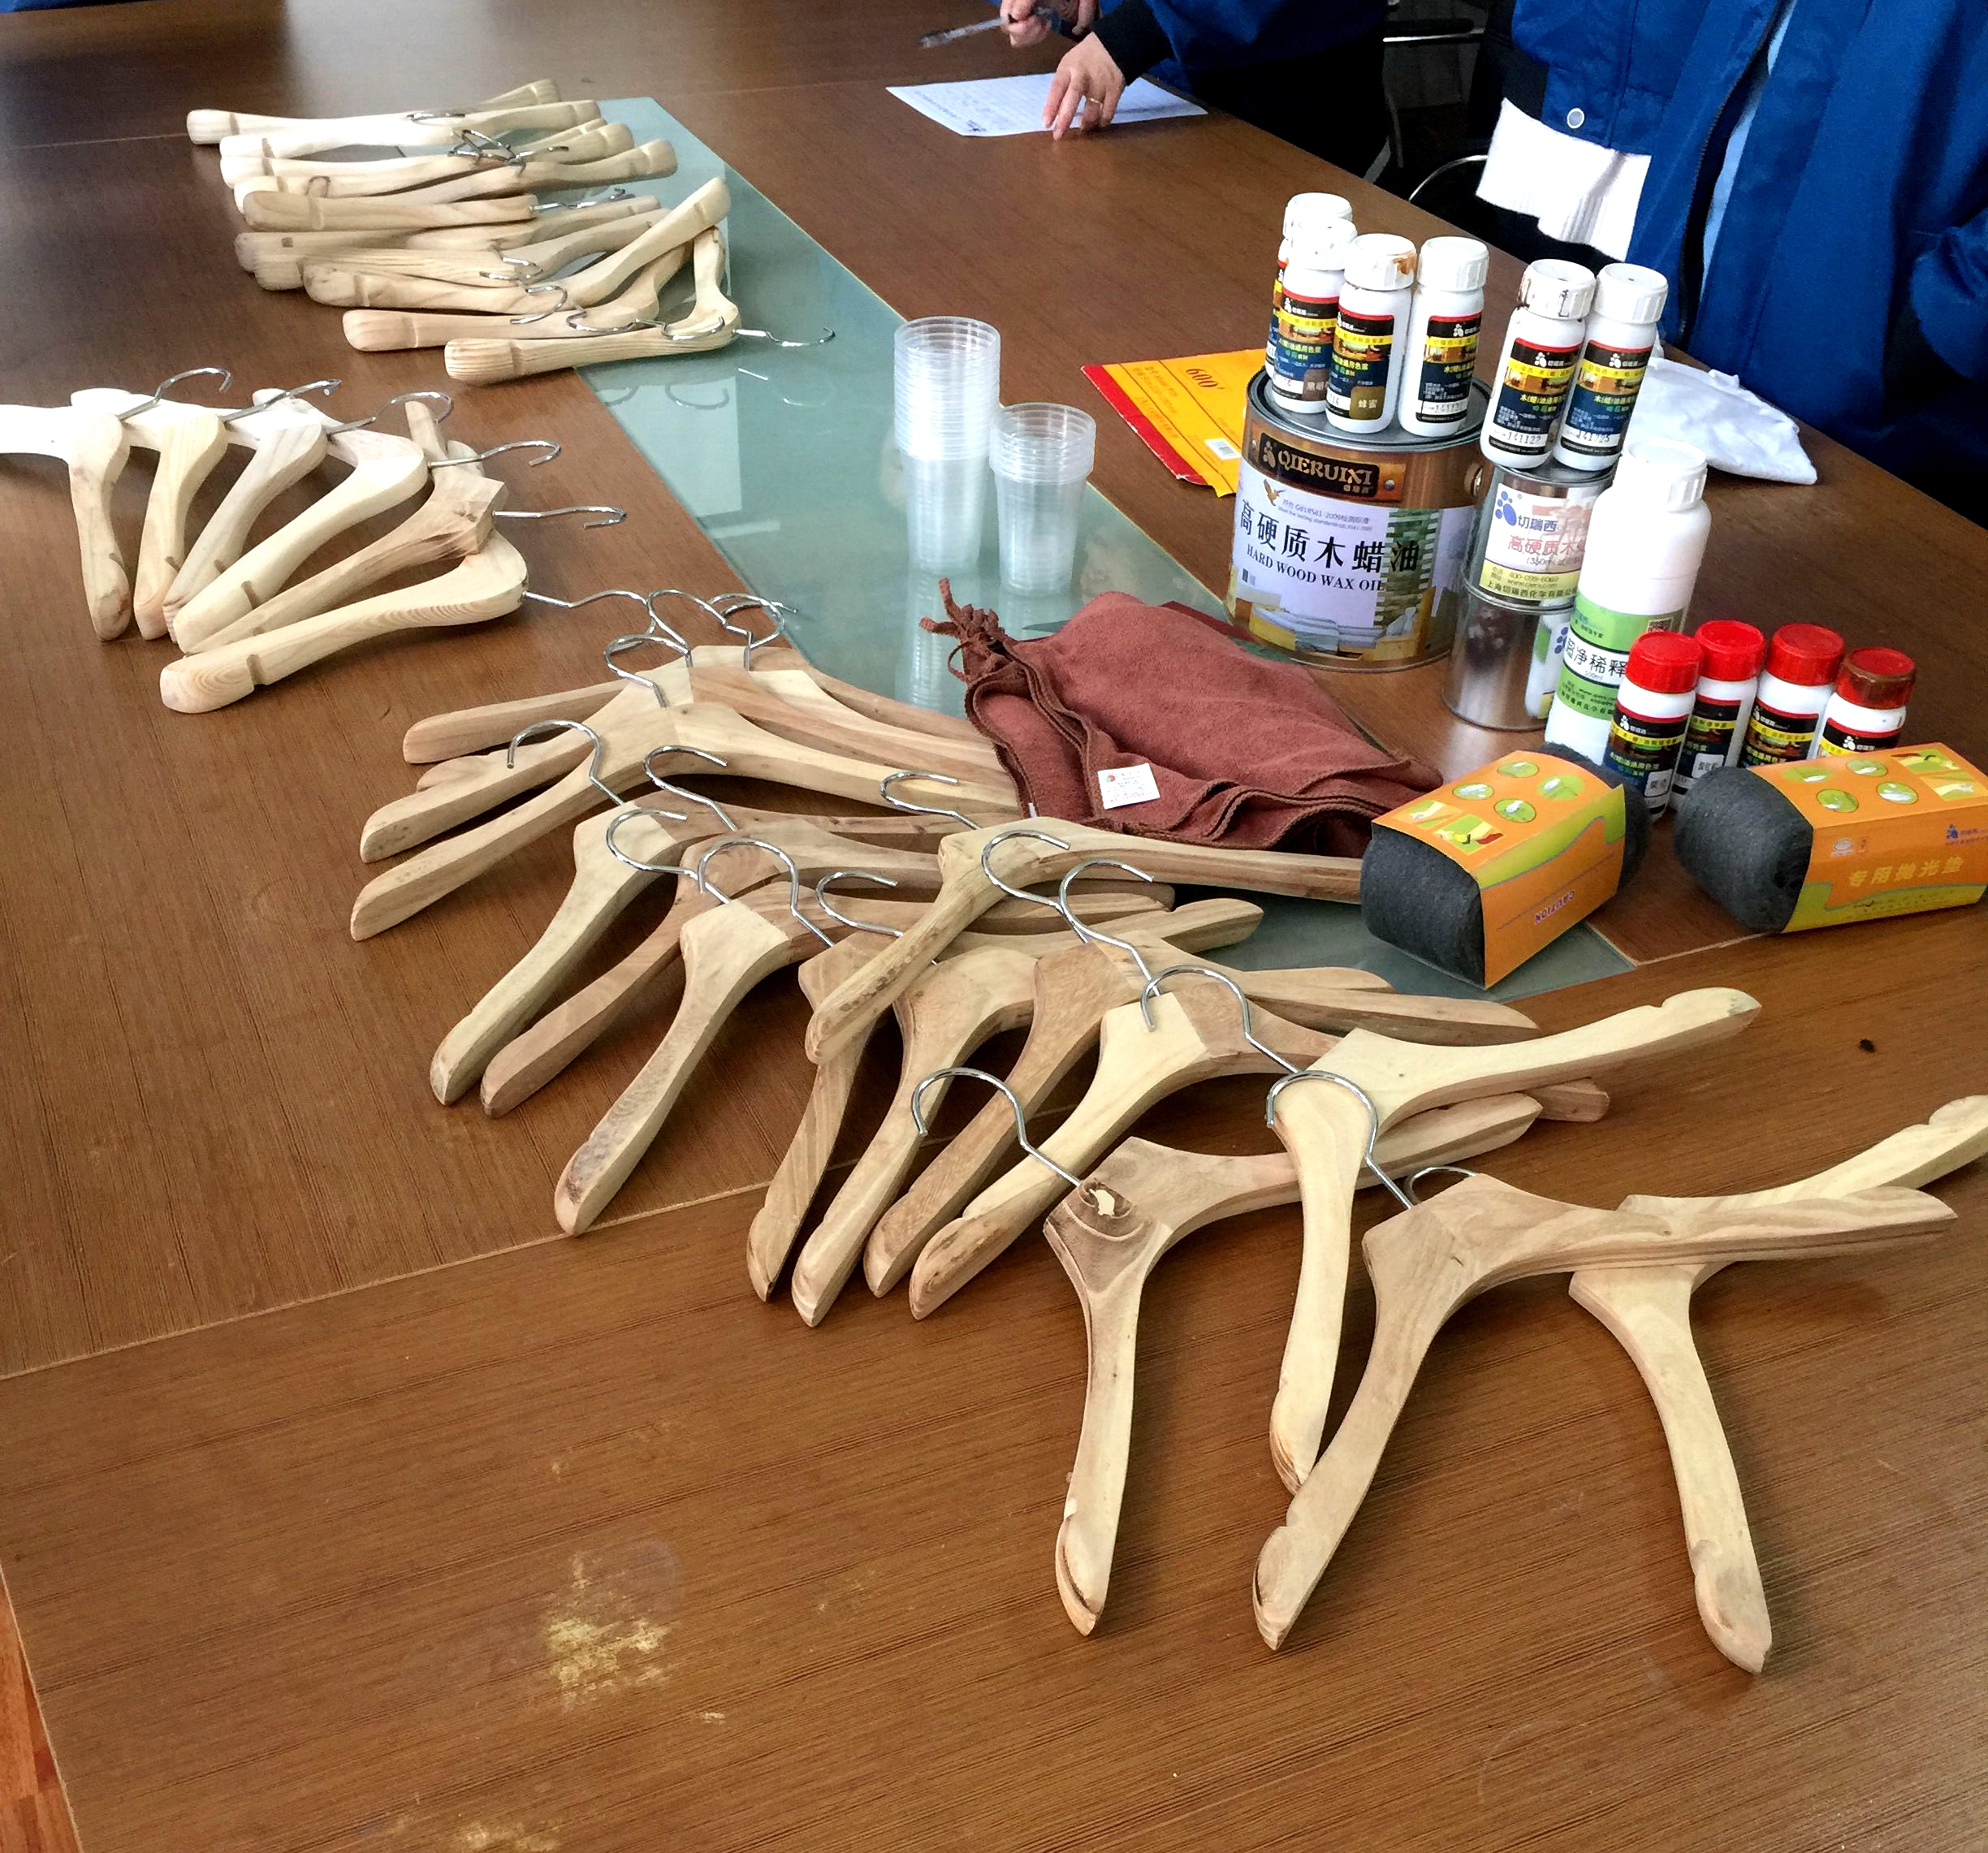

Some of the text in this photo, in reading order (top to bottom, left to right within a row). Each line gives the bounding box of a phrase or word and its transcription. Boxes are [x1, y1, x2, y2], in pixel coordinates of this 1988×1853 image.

[1277, 448, 1372, 486] QIERUIXI
[1240, 499, 1420, 574] 高硬质木蜡油
[1518, 515, 1558, 533] 切瑞西
[1247, 543, 1385, 592] HARD WOOD WAX OIL
[1534, 890, 1575, 926] CAUTION
